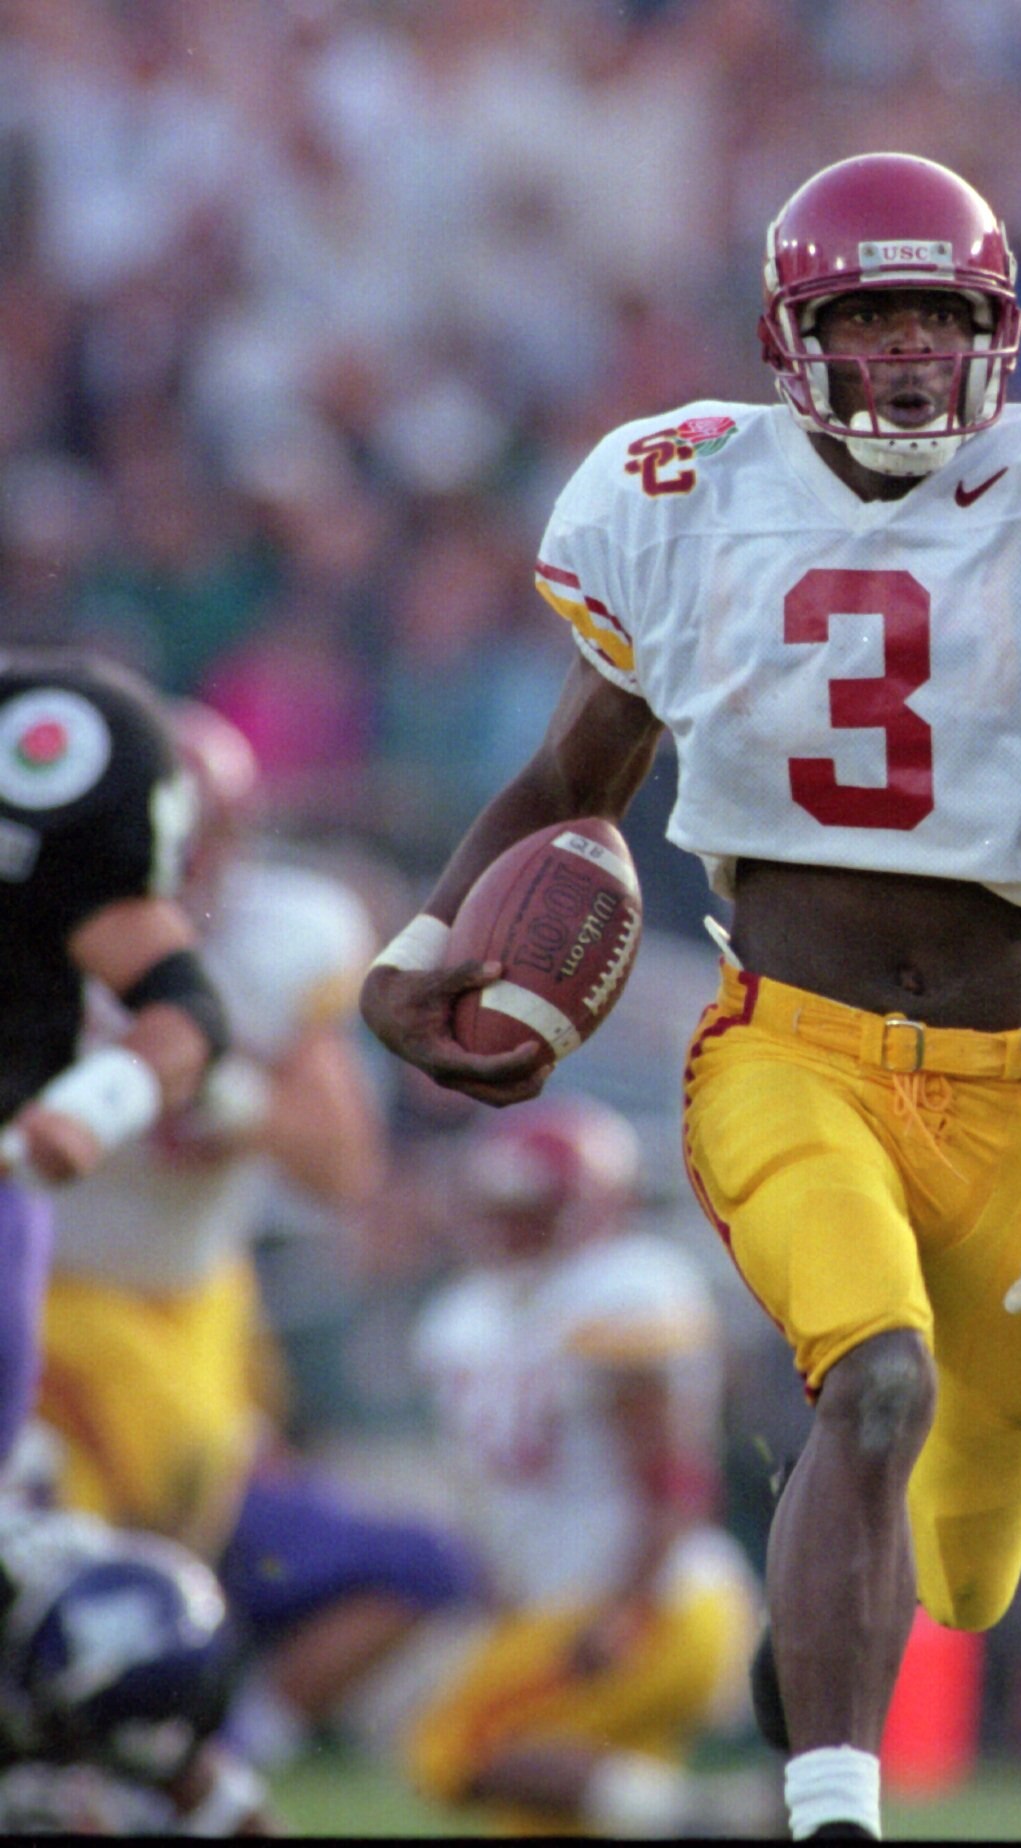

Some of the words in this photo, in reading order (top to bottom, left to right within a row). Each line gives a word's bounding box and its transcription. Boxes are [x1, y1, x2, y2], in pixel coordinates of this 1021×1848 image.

[882, 245, 929, 261] USC
[624, 427, 697, 499] SC
[783, 568, 935, 831] 3
[560, 890, 617, 977] Wilson
